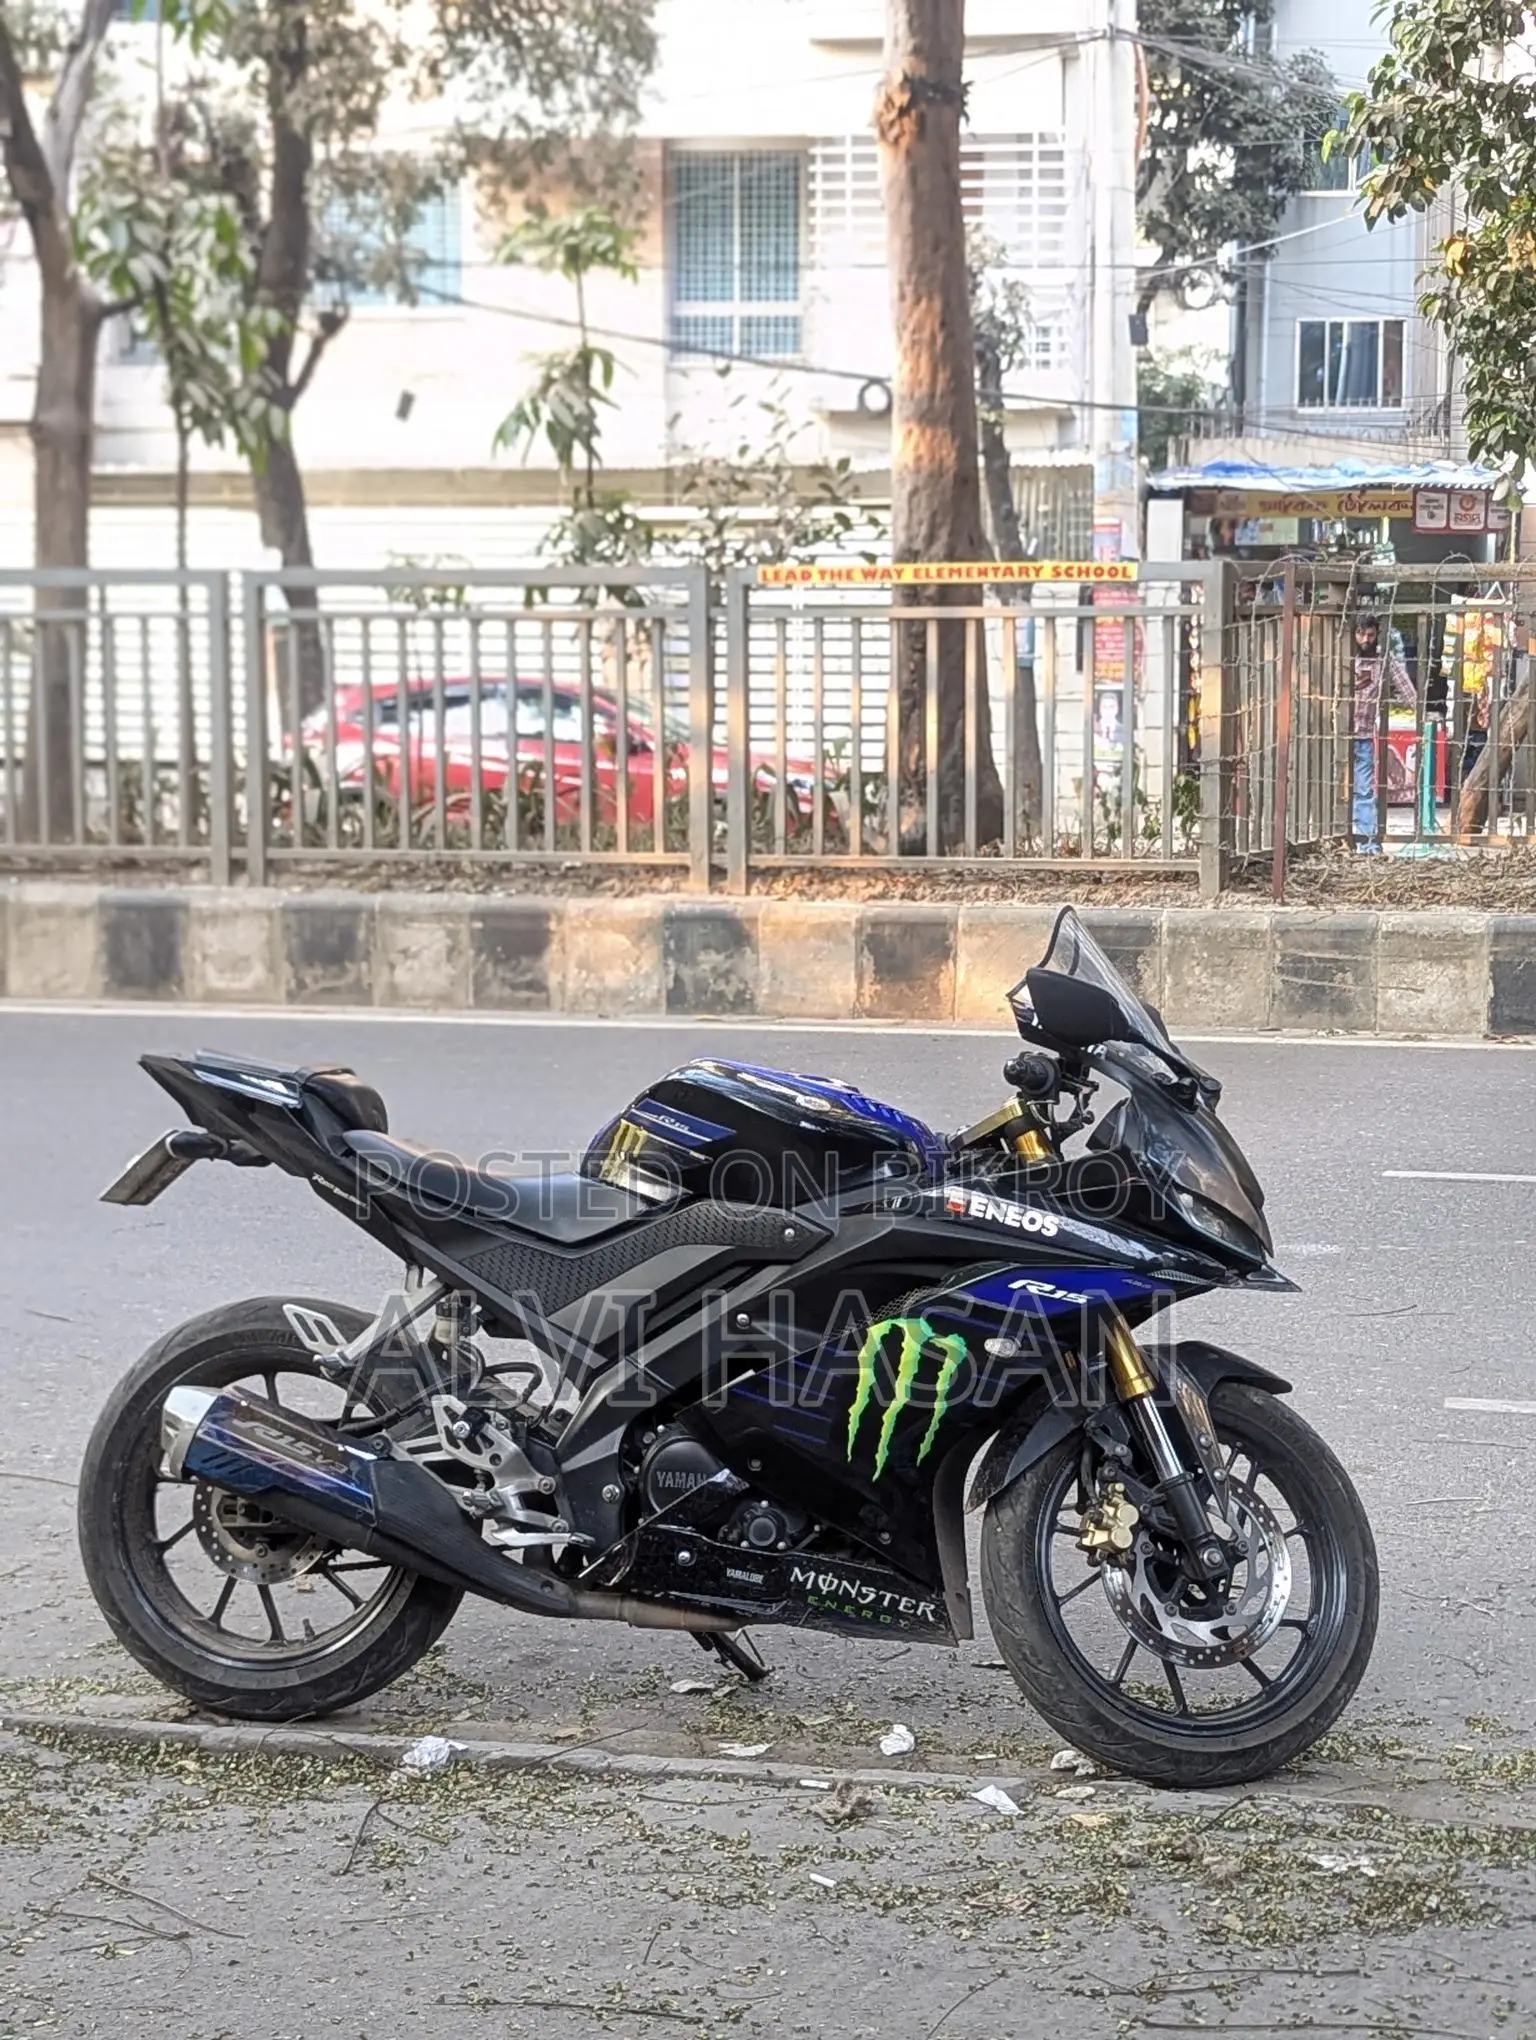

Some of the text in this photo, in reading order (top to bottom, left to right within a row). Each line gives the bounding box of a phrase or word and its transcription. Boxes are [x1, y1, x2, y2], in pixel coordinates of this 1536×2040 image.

[761, 564, 1133, 582] LEAD THE WAY ELEMENTARY SCHOOL
[968, 1195, 1061, 1237] ENEOS
[1007, 1278, 1095, 1304] R15
[656, 1471, 709, 1489] YAMAH
[807, 1595, 911, 1628] ENERGY
